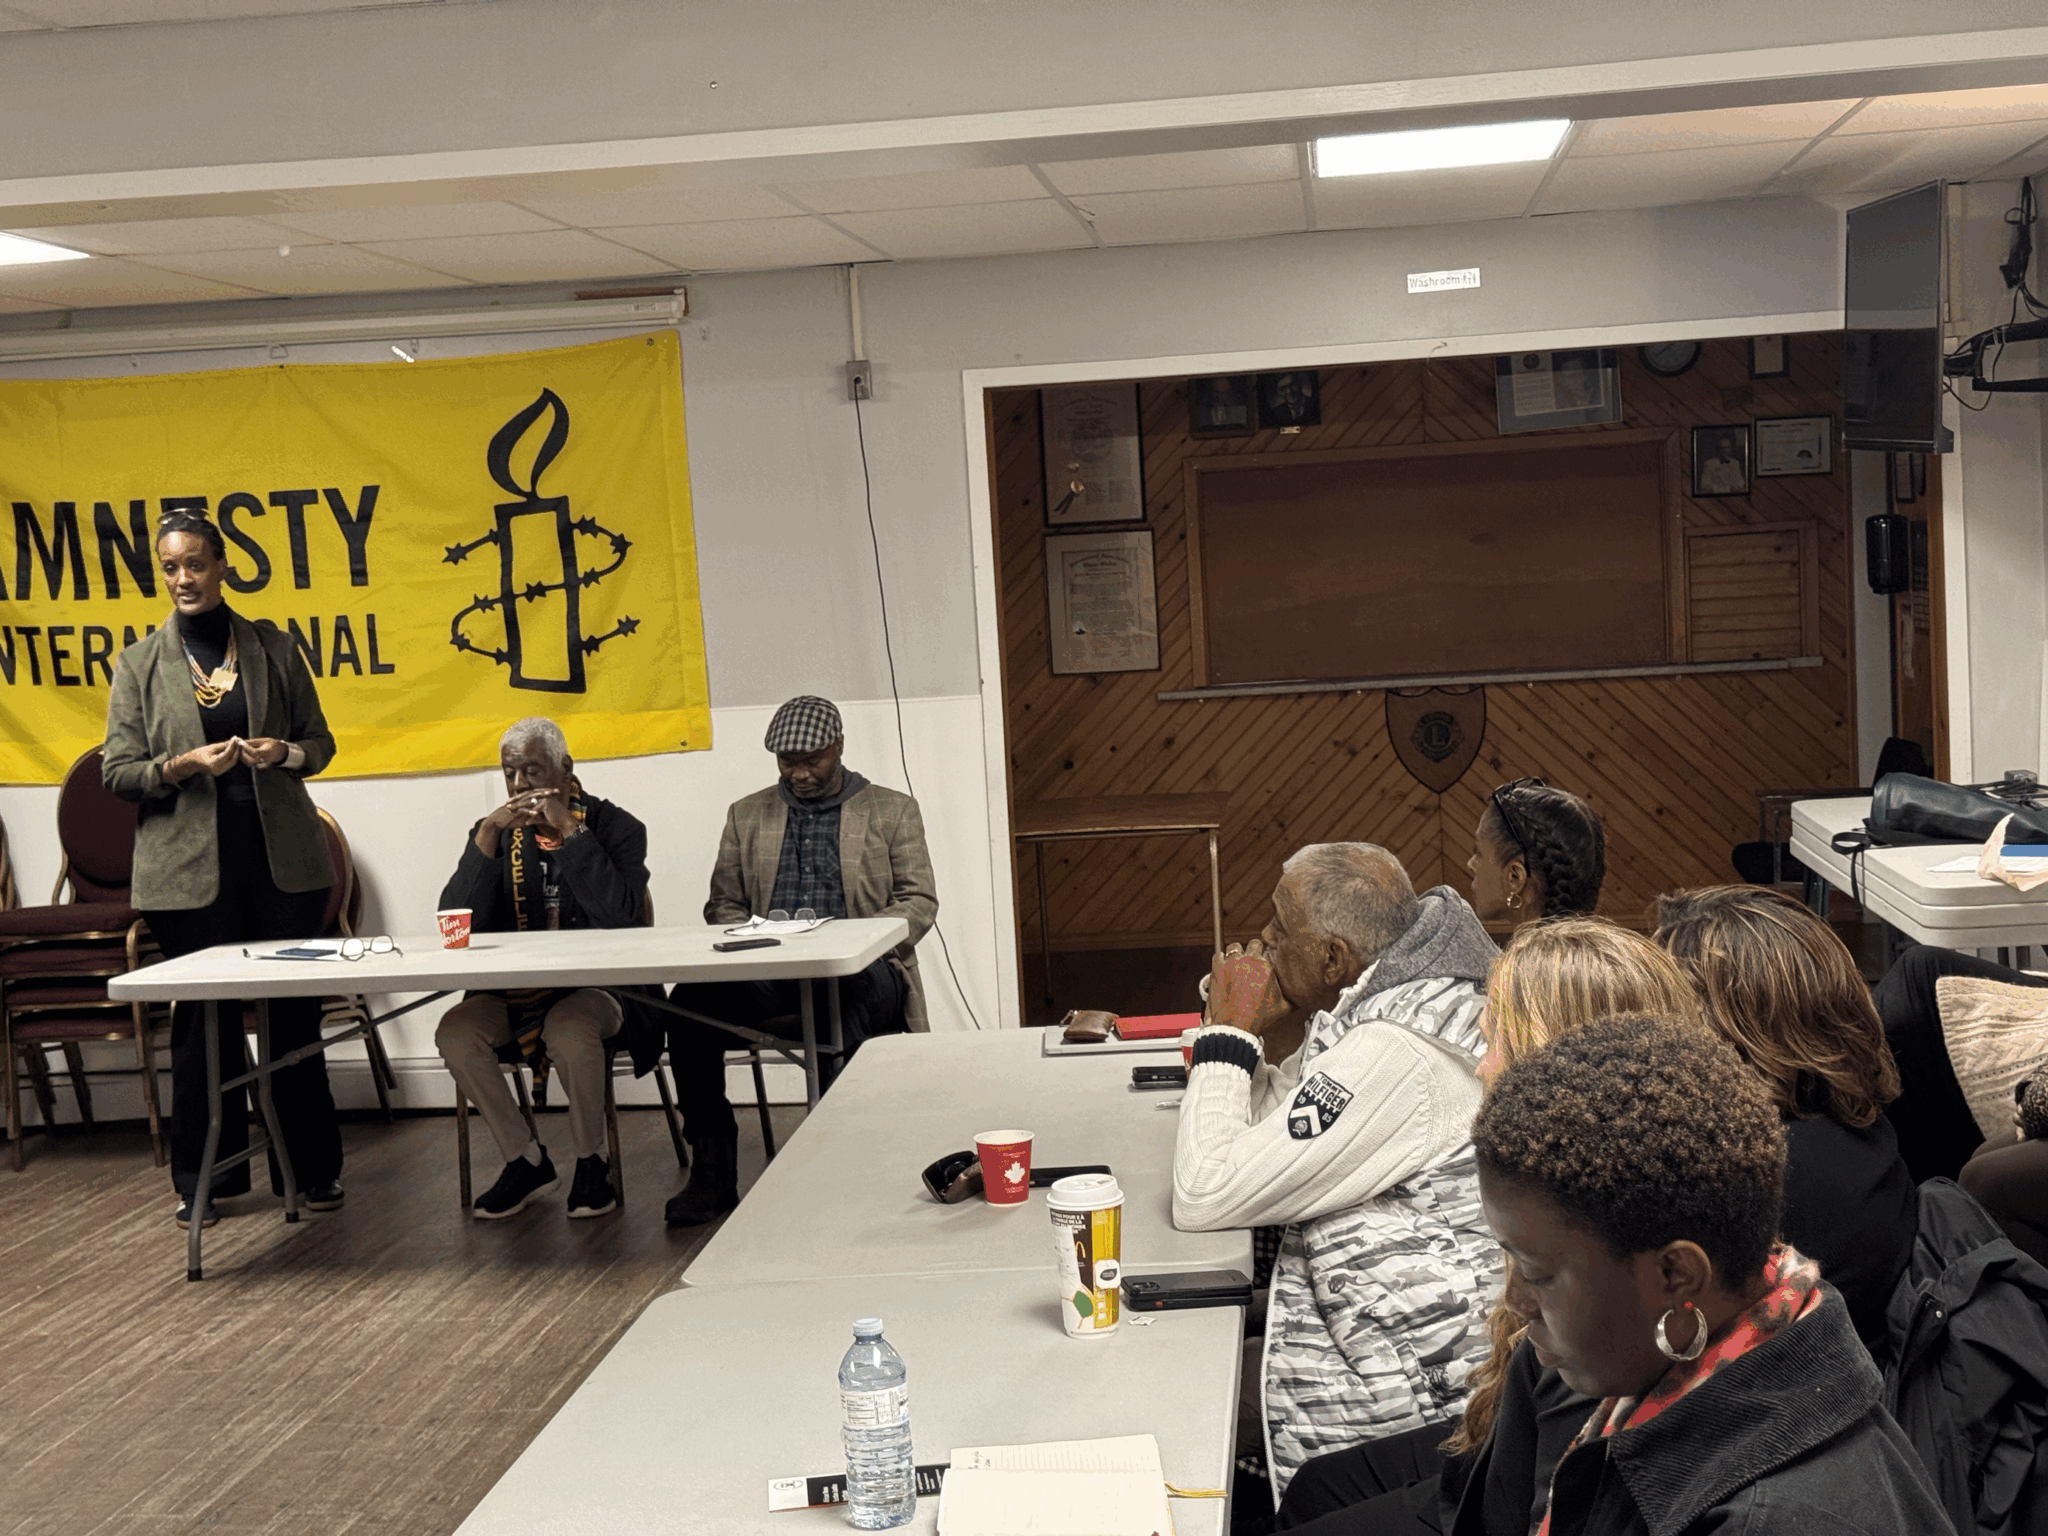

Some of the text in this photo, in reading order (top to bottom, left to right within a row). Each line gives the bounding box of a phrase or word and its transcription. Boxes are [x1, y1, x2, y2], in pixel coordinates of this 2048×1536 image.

[1409, 276, 1460, 288] Washroom
[0, 485, 380, 600] MNSTY
[438, 916, 460, 932] Tim
[1305, 1077, 1346, 1111] HILFIGER
[1320, 1075, 1343, 1095] TOMMY
[1322, 1113, 1333, 1123] 85
